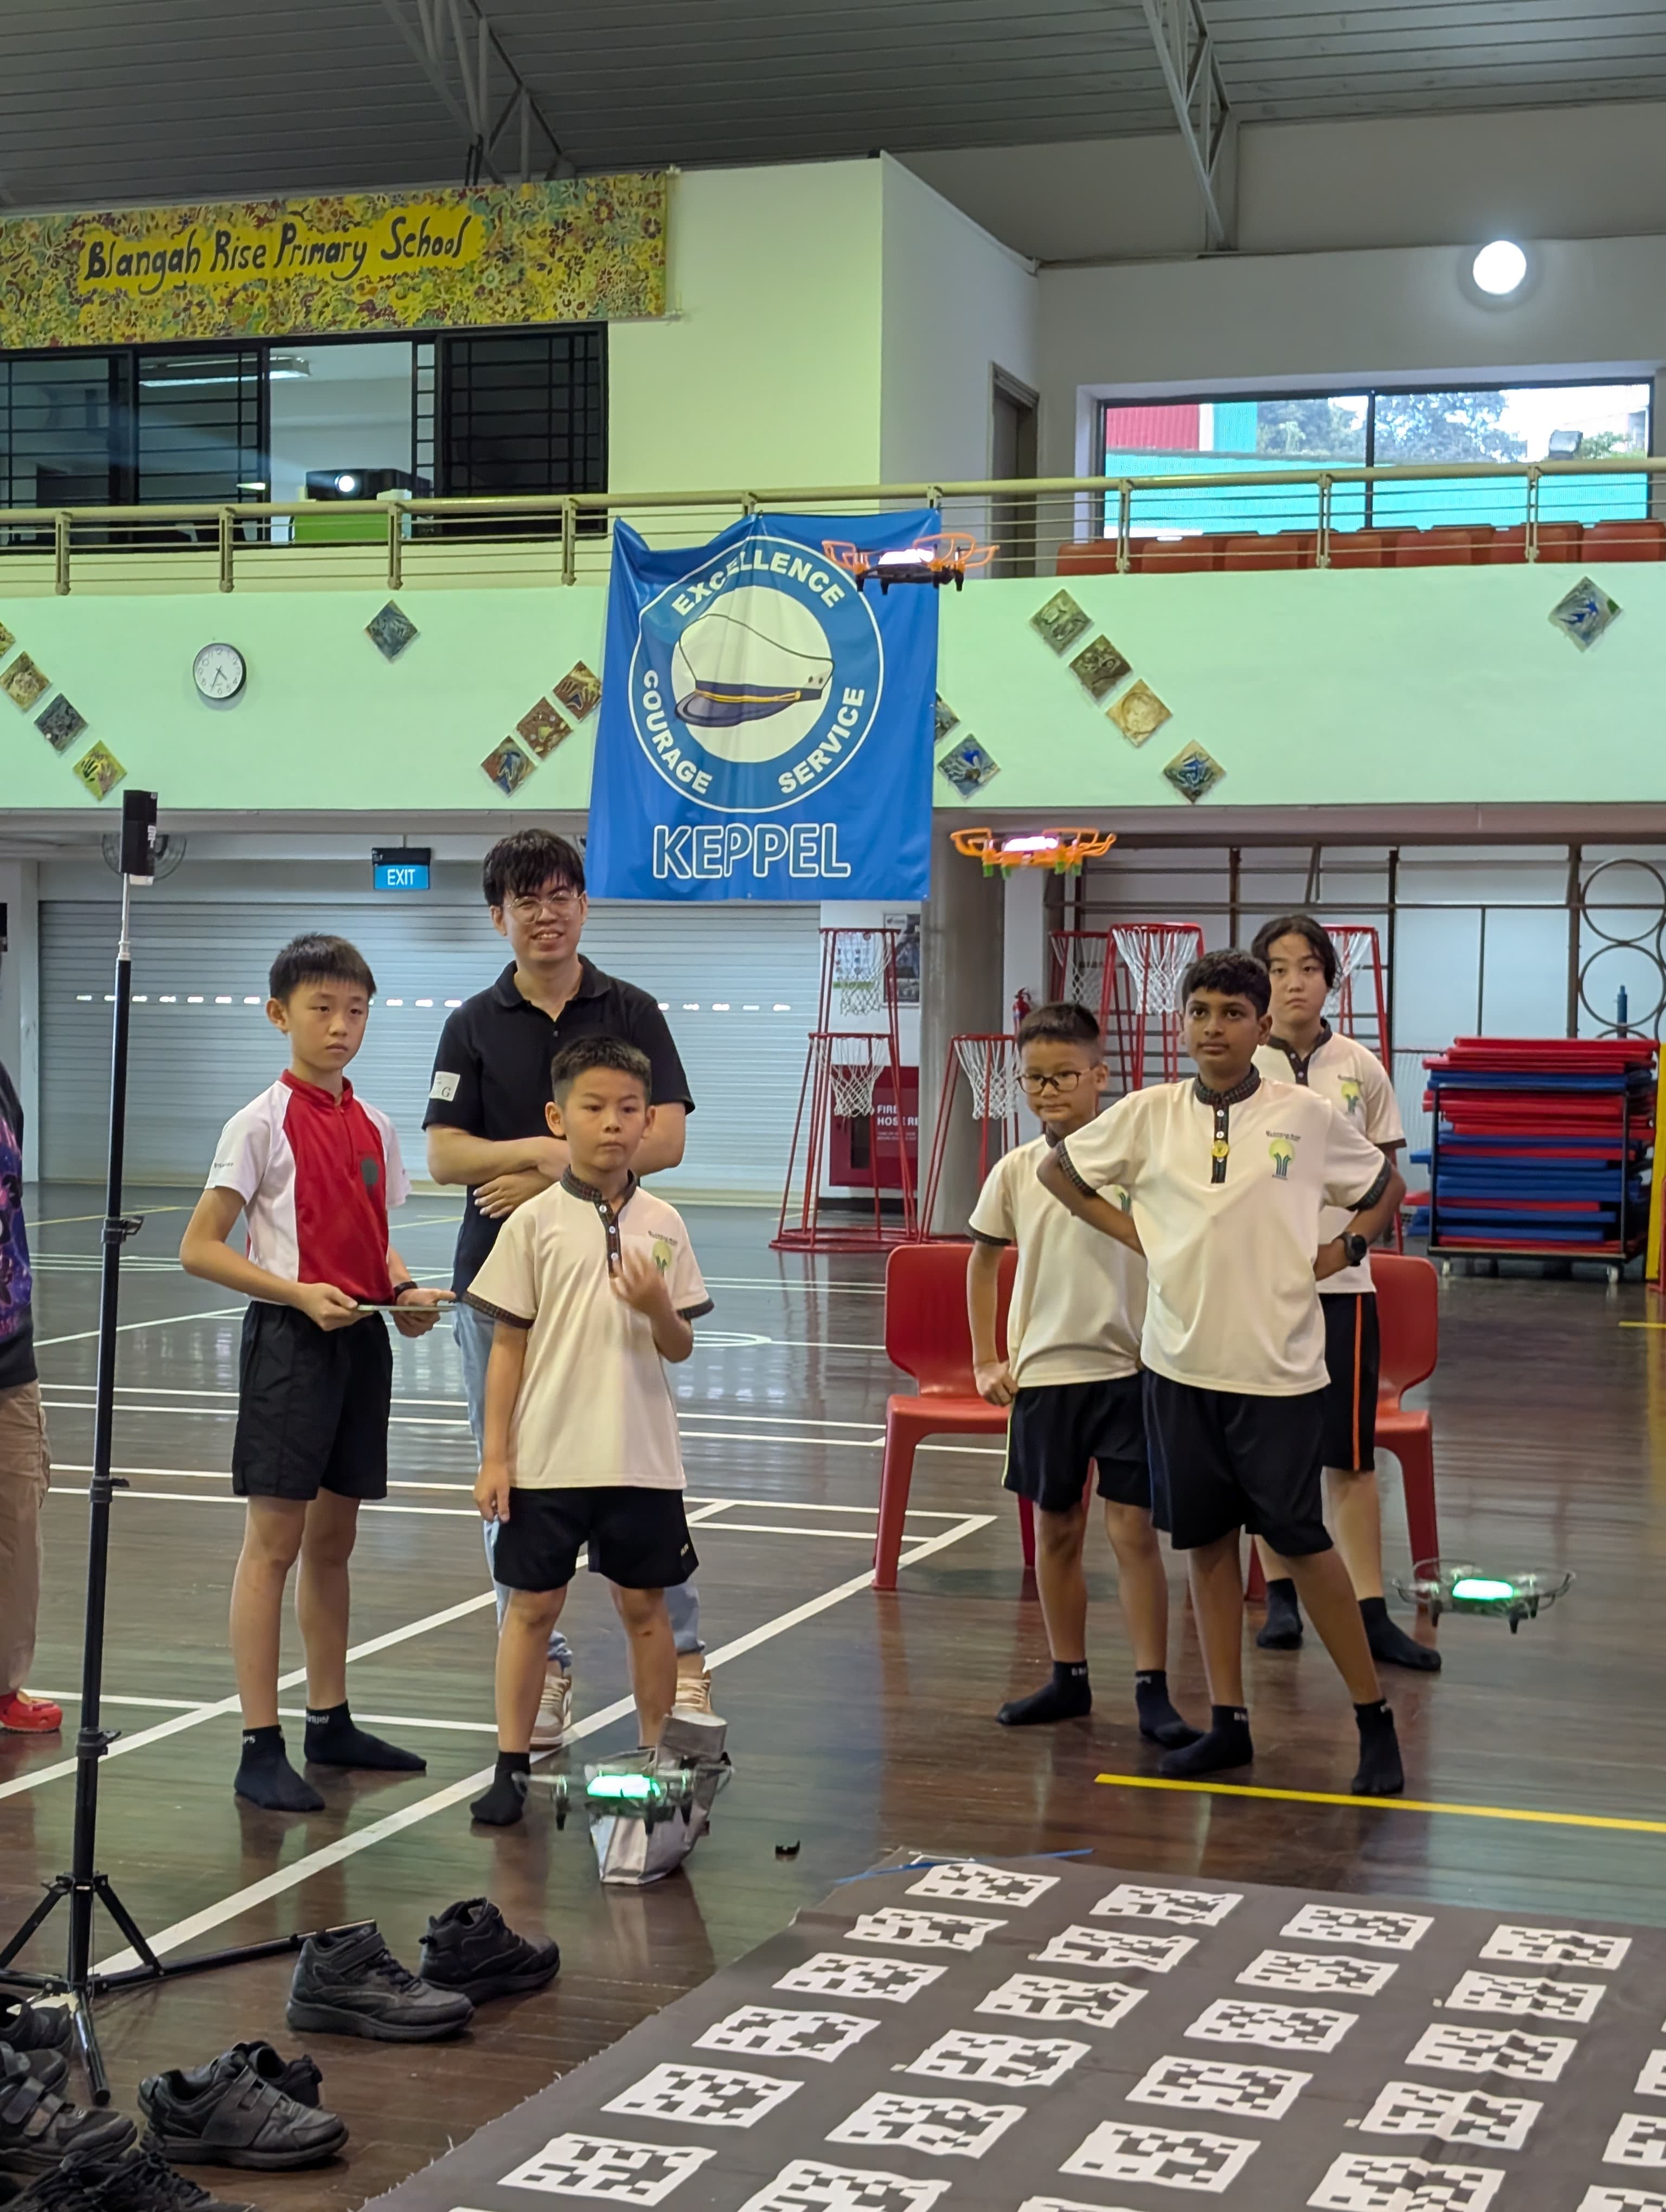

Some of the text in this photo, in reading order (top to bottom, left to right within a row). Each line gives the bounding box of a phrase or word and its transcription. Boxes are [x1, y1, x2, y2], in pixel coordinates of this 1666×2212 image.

[84, 215, 472, 295] Blangah Rise Primary School
[671, 549, 846, 616] EXCELLENCE
[643, 670, 713, 794] COURAGE
[778, 687, 865, 794] SERVICE
[387, 869, 416, 885] EXIT
[653, 822, 851, 879] KEPPEL
[441, 1086, 451, 1098] G
